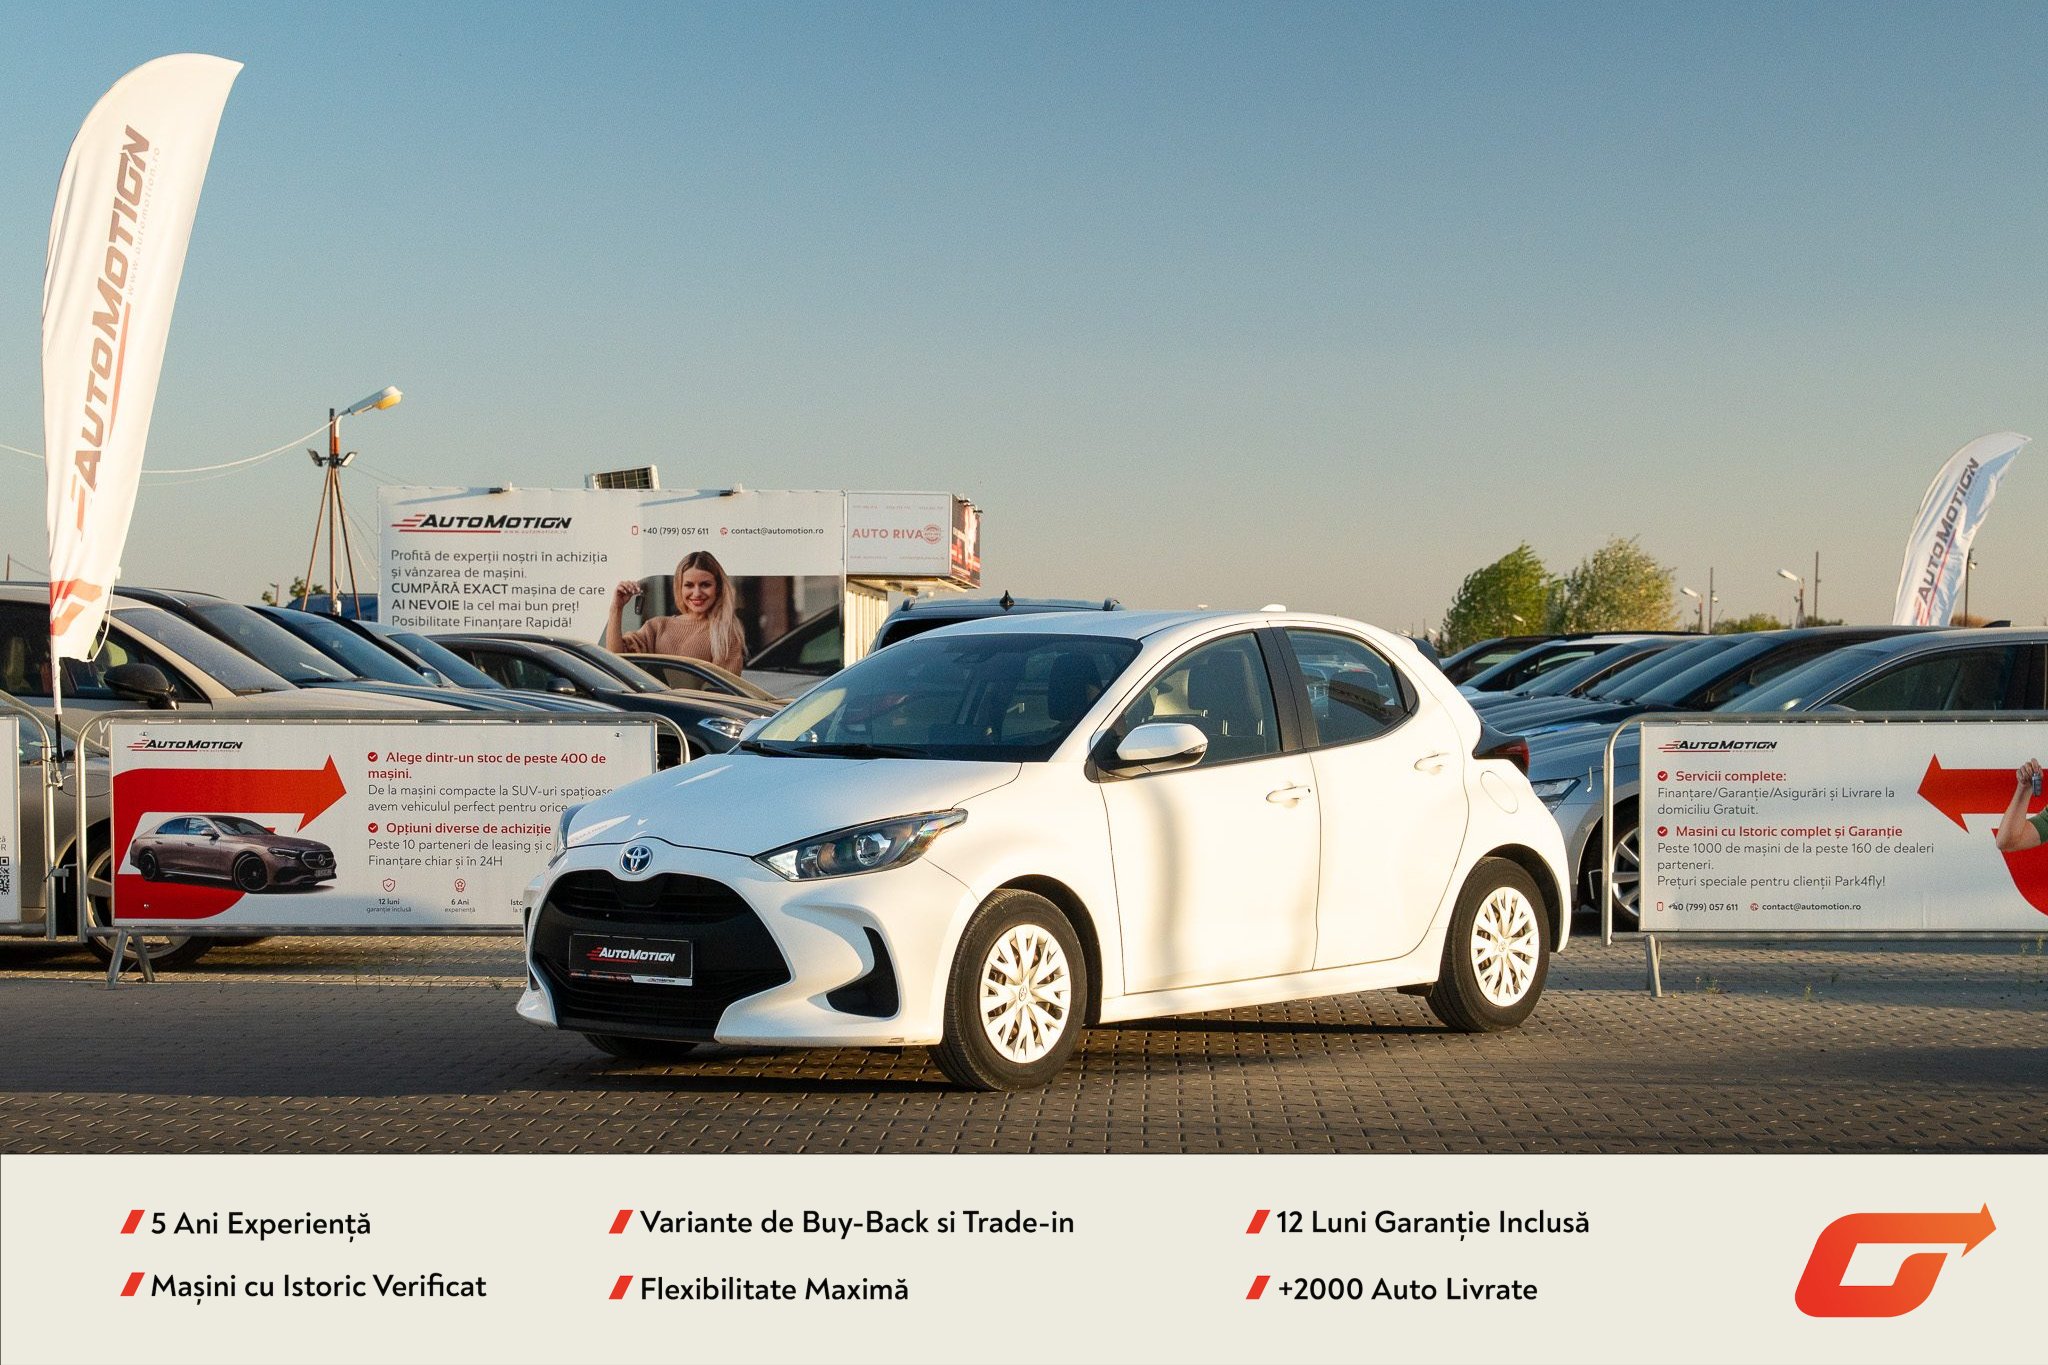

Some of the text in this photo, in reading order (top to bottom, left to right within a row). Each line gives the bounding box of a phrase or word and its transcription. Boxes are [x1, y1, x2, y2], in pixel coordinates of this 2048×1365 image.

[643, 526, 709, 536] +40 (799) 057 611
[731, 527, 824, 535] contact@automotion.ro
[852, 529, 889, 539] AUTO
[893, 529, 923, 540] RIVA
[391, 550, 608, 564] Profită de experții noștri în achiziția
[391, 567, 527, 580] și vânzarea de mașini.
[391, 581, 605, 596] CUMPĂRĂ EXACT mașina de care
[392, 600, 579, 614] AI NEVOIE la cel mai bun preț!
[392, 616, 572, 630] Posibilitate Finanțare Rapidă!
[386, 753, 606, 765] Alege dintr-un stoc de peste 400 de
[368, 769, 412, 780] mașini.
[1676, 771, 1786, 783] Servicii complete:
[368, 785, 384, 796] De
[388, 785, 397, 796] la
[401, 786, 436, 798] mașini
[439, 786, 496, 799] compacte
[500, 786, 509, 796] la
[512, 786, 557, 797] SUV-uri
[1658, 787, 1894, 801] Finanțare/Garanție/Asigurări și Livrare la
[368, 802, 398, 812] avem
[401, 801, 450, 812] vehiculul
[454, 801, 495, 814] perfect
[498, 803, 536, 814] pentru
[1658, 804, 1759, 815] domiciliu Gratuit.
[386, 823, 551, 837] Opțiuni diverse de achiziție
[1676, 825, 1902, 840] Masini cu Istoric complet și Garanție
[368, 840, 400, 850] Peste
[403, 840, 415, 850] 10
[419, 840, 471, 853] parteneri
[474, 840, 489, 851] de
[492, 840, 531, 853] leasing
[534, 841, 543, 853] și
[1658, 842, 1934, 857] Peste 1000 de mașini de la peste 160 de dealeri
[368, 855, 503, 870] Finanțare chiar și în 24H
[1658, 859, 1714, 872] parteneri.
[1658, 875, 1886, 890] Prețuri speciale pentru clienții Park4fly!
[1686, 903, 1706, 912] (799)
[1762, 903, 1861, 912] contact@automotion.ro
